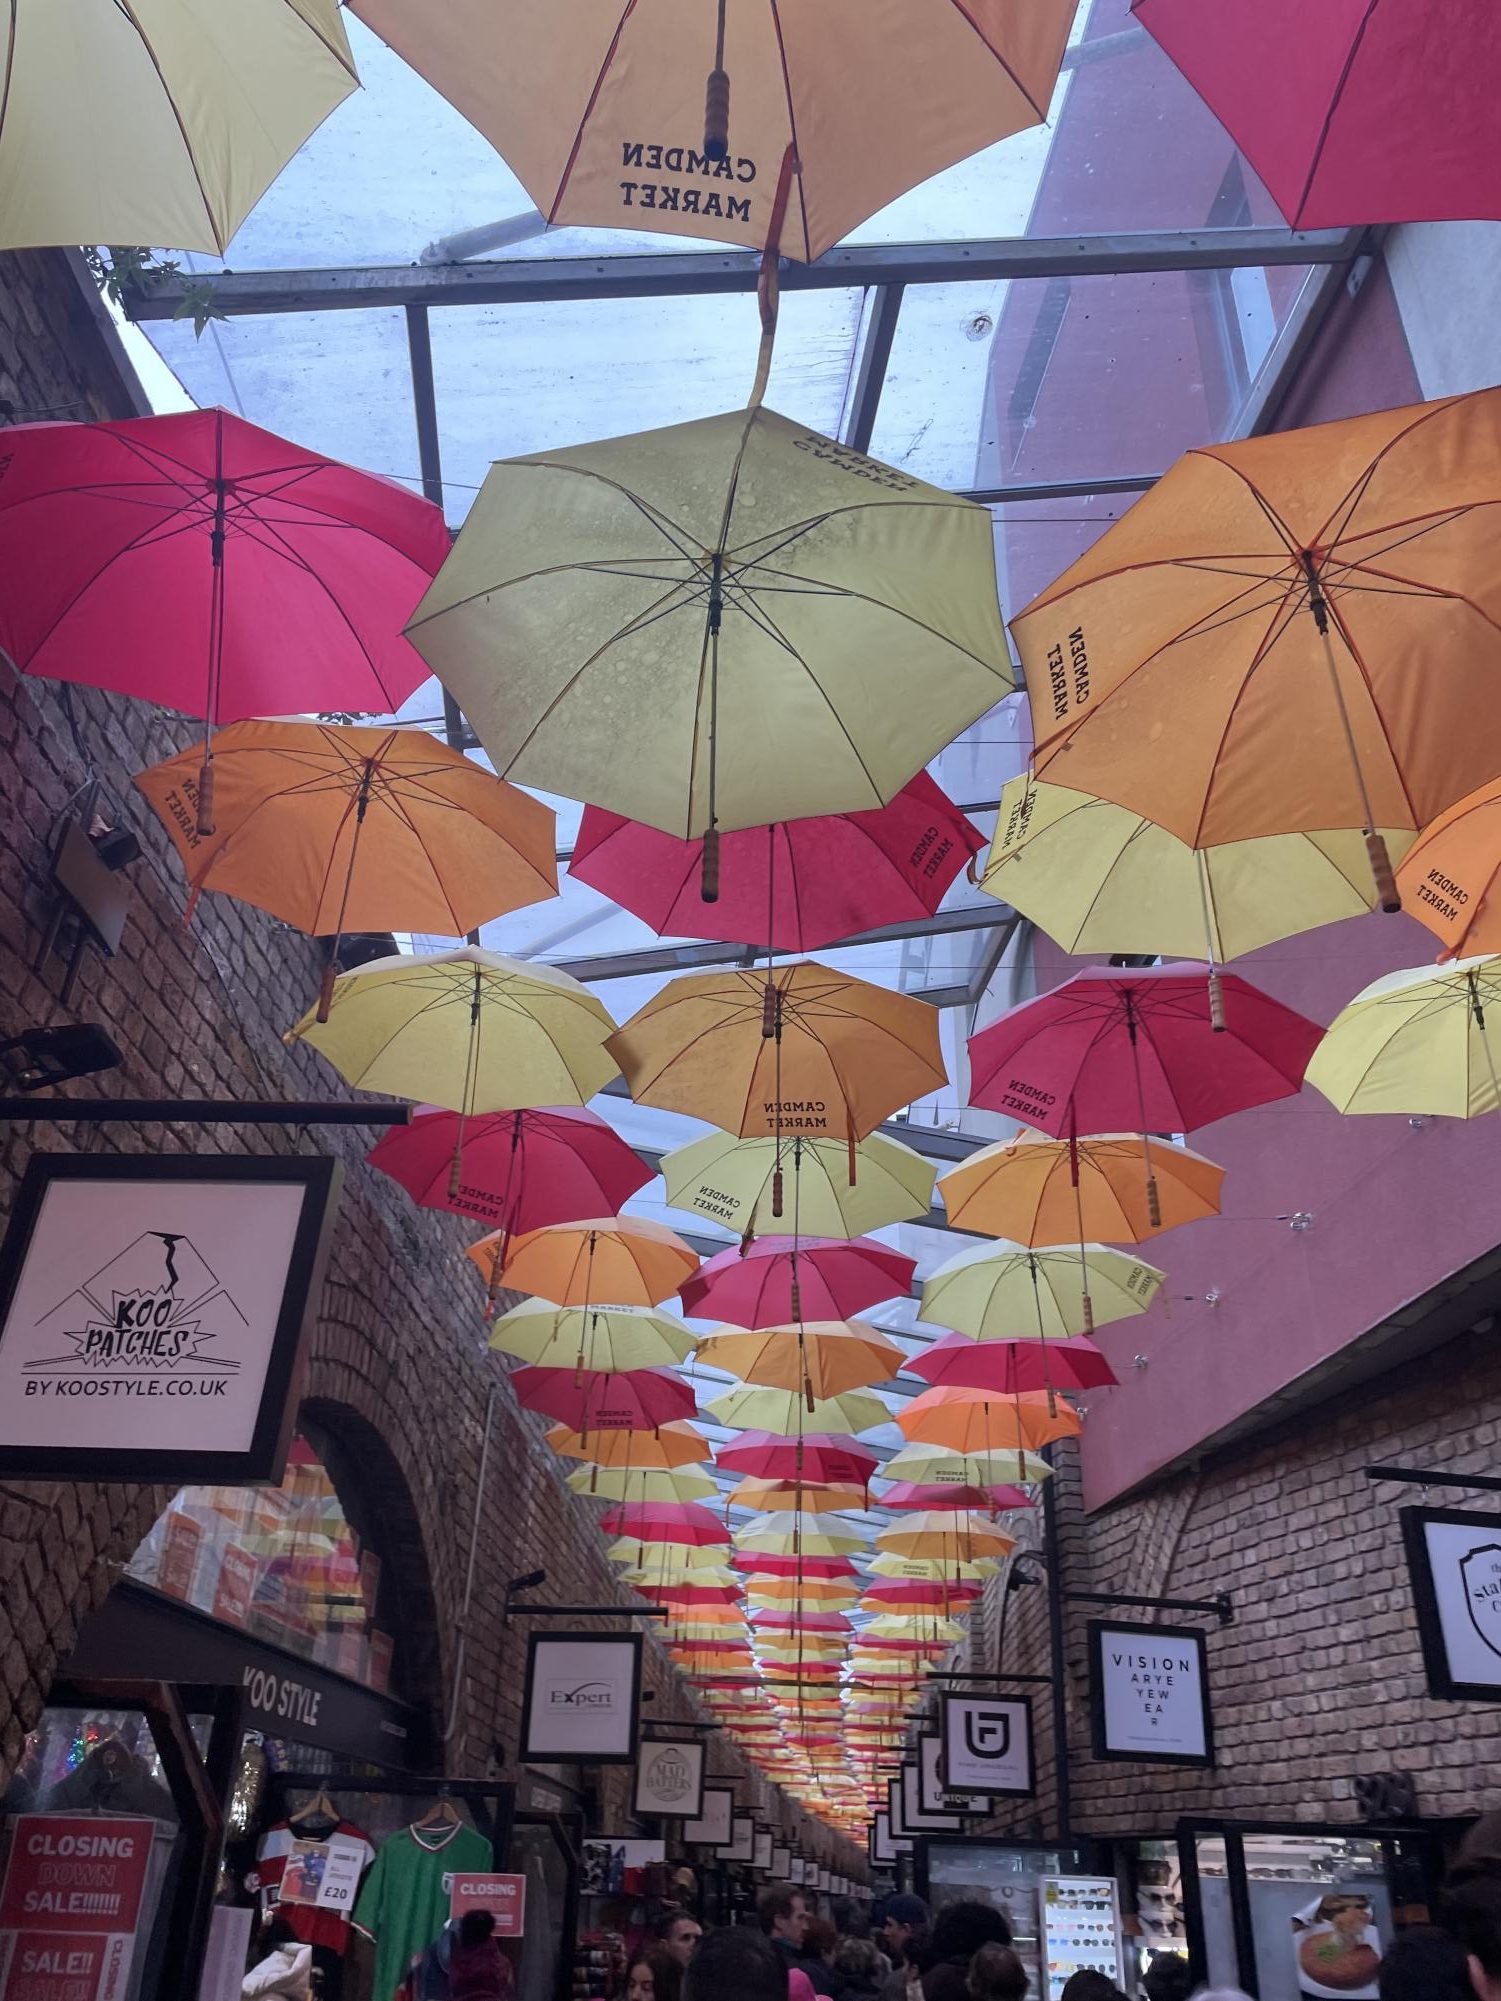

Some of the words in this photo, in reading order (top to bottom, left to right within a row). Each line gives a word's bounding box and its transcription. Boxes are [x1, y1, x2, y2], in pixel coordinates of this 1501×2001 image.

[116, 1299, 172, 1329] KOO
[85, 1329, 189, 1357] PATCHES
[25, 1380, 52, 1396] BY
[55, 1380, 228, 1396] KOOSTYLE.CO.UK
[1473, 1578, 1501, 1603] Sta
[1112, 1654, 1189, 1672] VISION
[1131, 1673, 1173, 1686] ARYE
[277, 1680, 321, 1726] STYLE
[551, 1690, 611, 1706] Expert
[1136, 1689, 1169, 1699] YEW
[1145, 1703, 1163, 1713] EA
[28, 1834, 134, 1857] CLOSING
[37, 1862, 117, 1887] DOWN
[324, 1887, 348, 1899] £20
[460, 1883, 517, 1896] CLOSING
[21, 1951, 94, 1974] SALE!!
